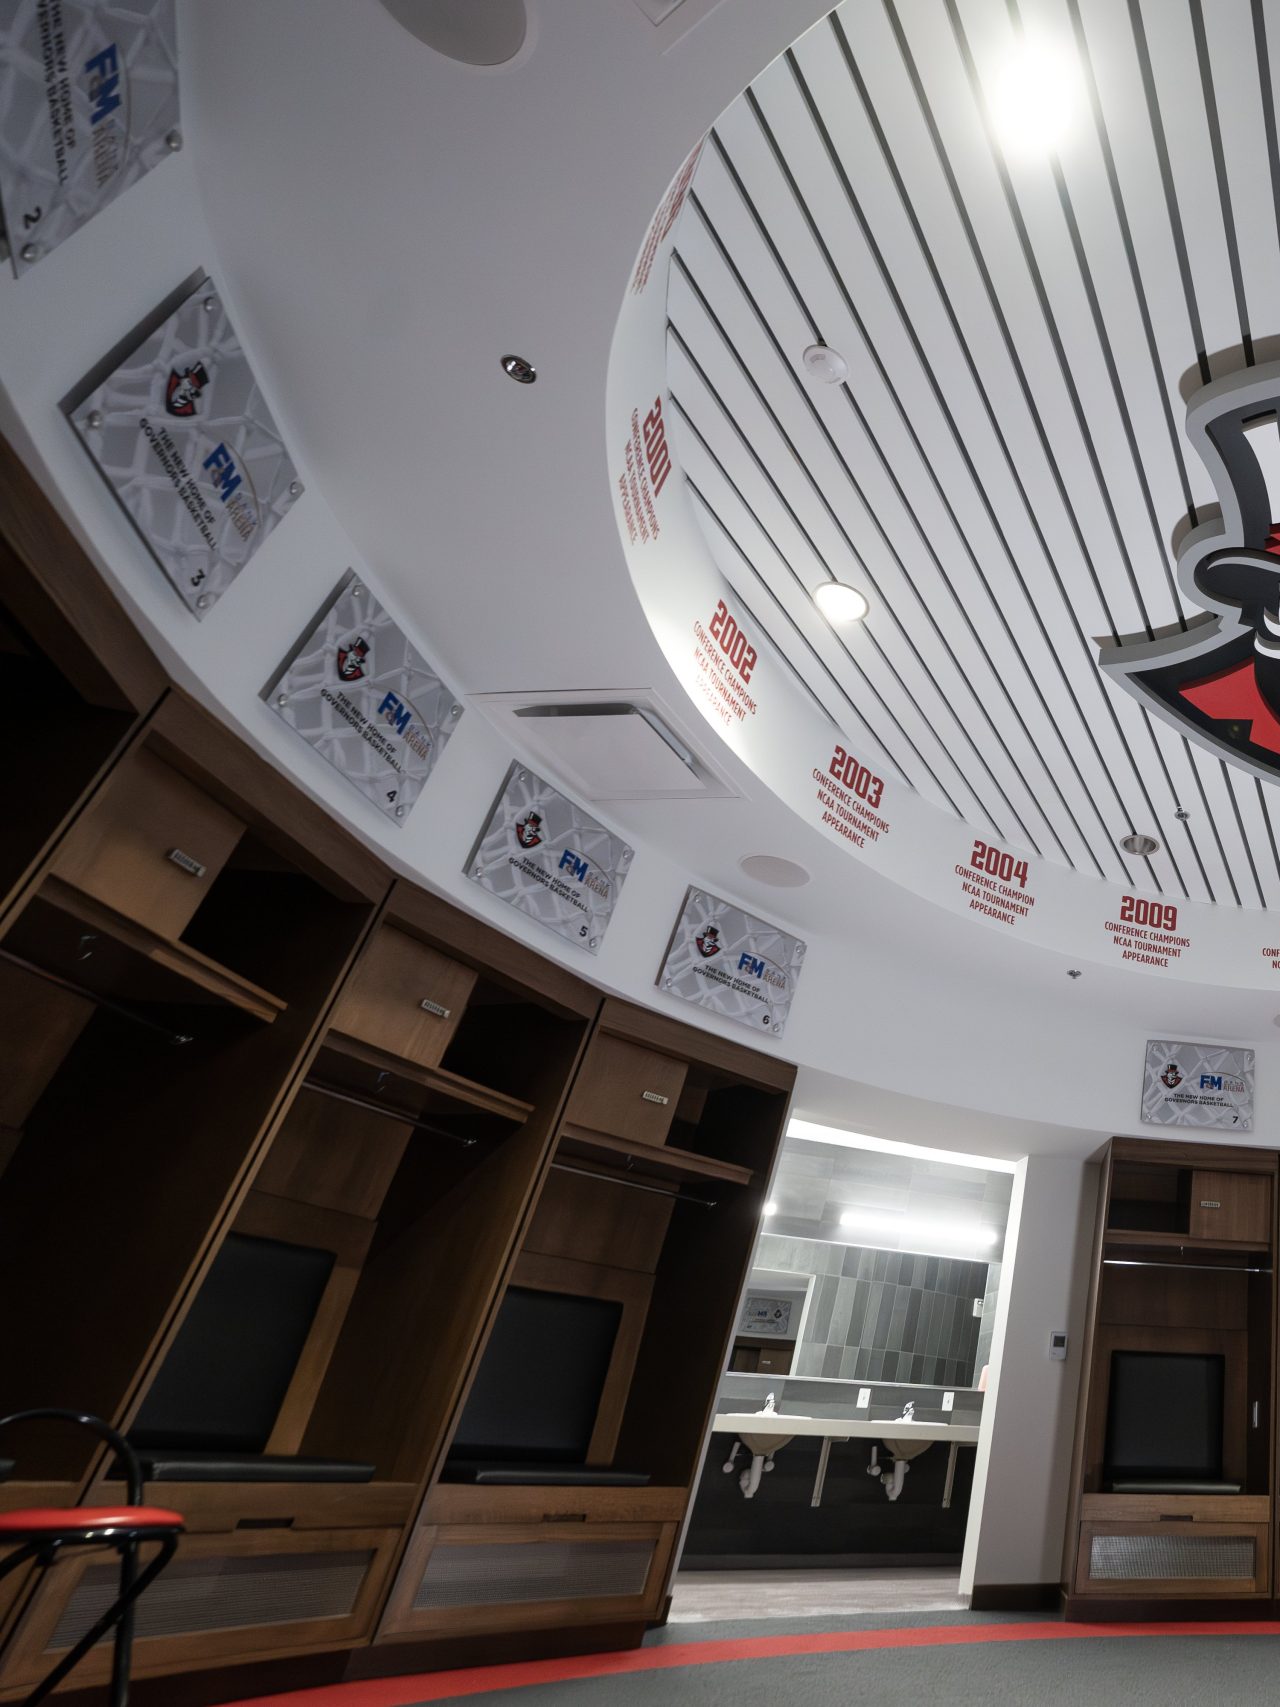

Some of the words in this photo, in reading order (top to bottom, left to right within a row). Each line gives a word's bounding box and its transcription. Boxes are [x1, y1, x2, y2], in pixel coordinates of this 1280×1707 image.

[23, 204, 42, 231] 2
[643, 395, 671, 497] 2001
[189, 566, 206, 589] 3
[709, 599, 757, 685] 2002
[693, 620, 725, 674] CONFERENCE
[725, 669, 757, 715] CHAMPIONS
[694, 647, 708, 671] NCAA
[709, 669, 746, 721] TOURNAMENT
[829, 745, 884, 809] 2003
[384, 786, 397, 804] 4
[812, 768, 852, 806] CONFERENCE
[852, 801, 890, 834] CHAMPIONS
[817, 789, 834, 810] NCAA
[836, 804, 880, 842] TOURNAMENT
[822, 811, 866, 848] APPEARANCE
[970, 840, 1028, 888] 2004
[955, 865, 998, 892] CONFERENCE
[998, 885, 1034, 906] CHAMPION
[962, 882, 980, 897] NCAA
[982, 890, 1029, 917] TOURNAMENT
[970, 900, 1015, 926] APPEARANCE
[1120, 896, 1178, 932] 2009
[578, 924, 588, 938] 5
[1104, 922, 1148, 940] CONFERENCE
[1150, 932, 1190, 948] CHAMPIONS
[1114, 936, 1132, 948] NCAA
[1134, 940, 1182, 958] TOURNAMENT
[1122, 950, 1168, 968] APPEARANCE
[761, 1013, 770, 1025] 6
[1231, 1115, 1238, 1123] 7
